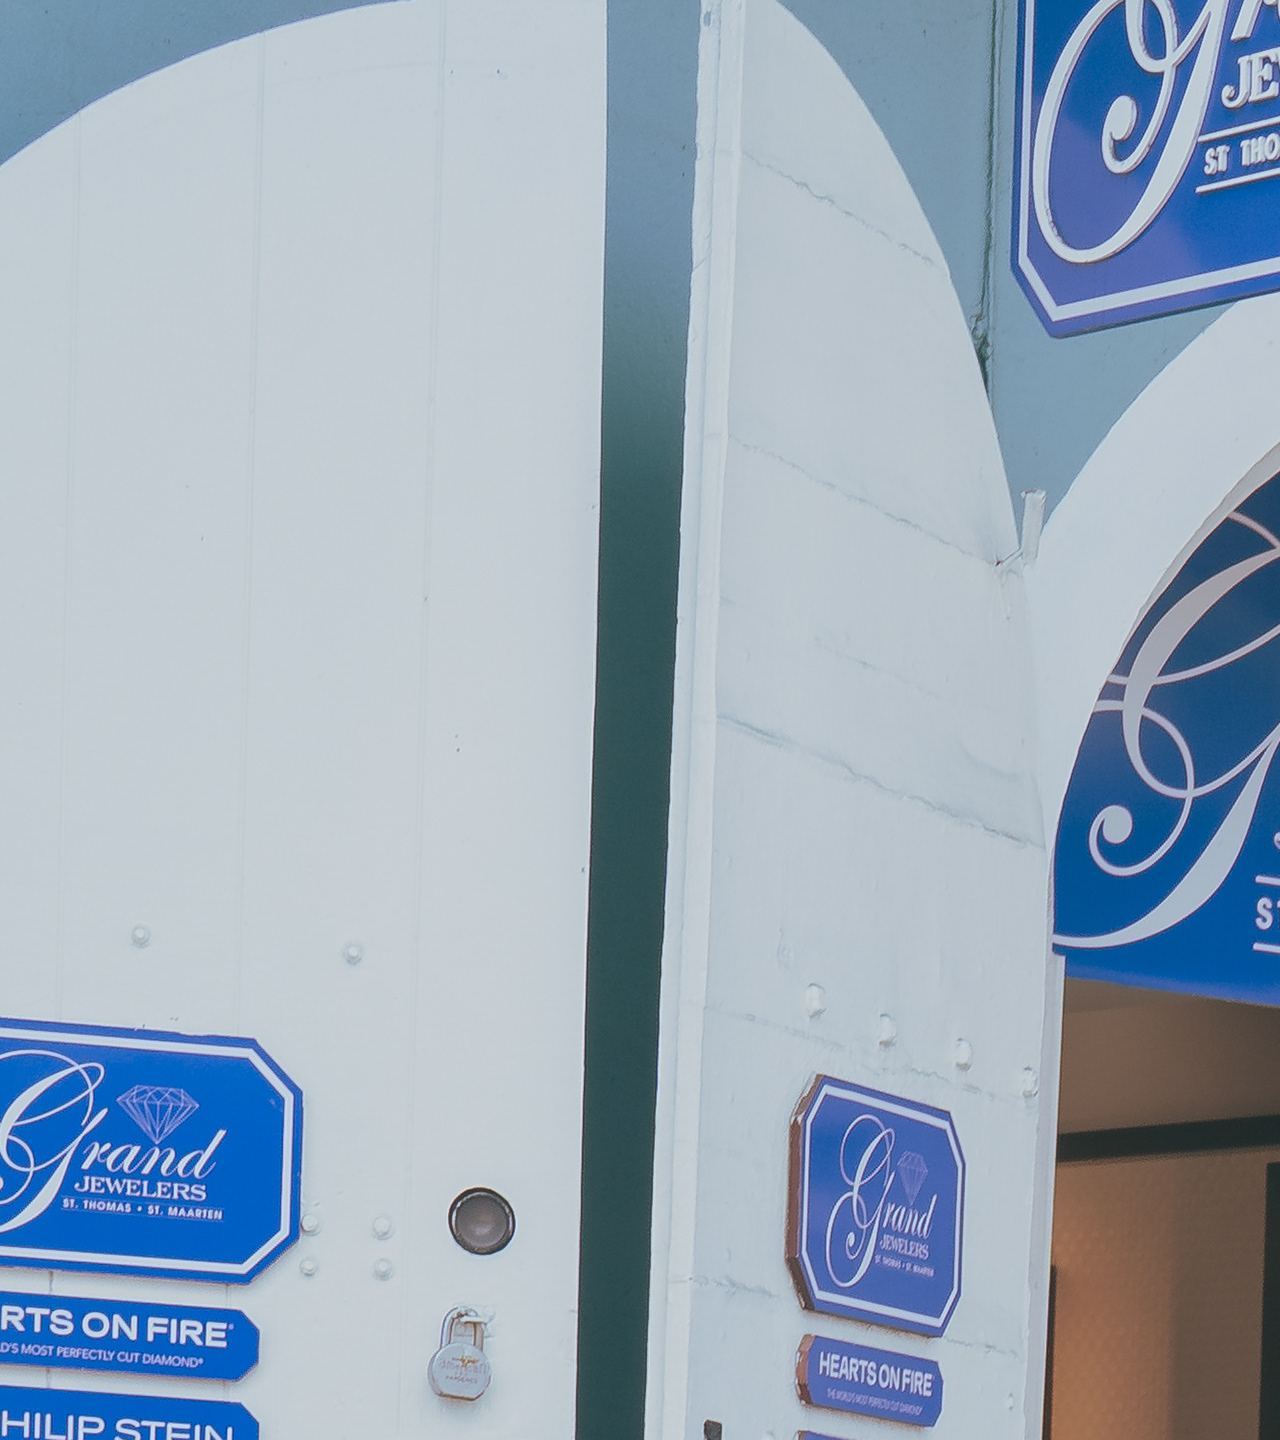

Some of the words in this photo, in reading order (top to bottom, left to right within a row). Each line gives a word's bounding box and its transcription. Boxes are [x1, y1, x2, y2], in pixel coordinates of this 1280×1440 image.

[1204, 144, 1230, 176] ST
[0, 1049, 227, 1232] Grand
[74, 1175, 207, 1202] JEWELERS
[826, 1114, 937, 1287] Grand
[83, 1201, 132, 1213] THOMAS
[168, 1206, 223, 1220] MAARTEN
[879, 1234, 929, 1260] JEWELERS
[81, 1311, 138, 1341] ON
[146, 1316, 228, 1348] FIRE
[21, 1343, 54, 1357] MOST
[56, 1345, 114, 1360] PERFECTLY
[117, 1351, 140, 1363] CUT
[819, 1351, 877, 1386] HEARTS
[879, 1363, 900, 1391] ON
[902, 1368, 933, 1397] FIRE
